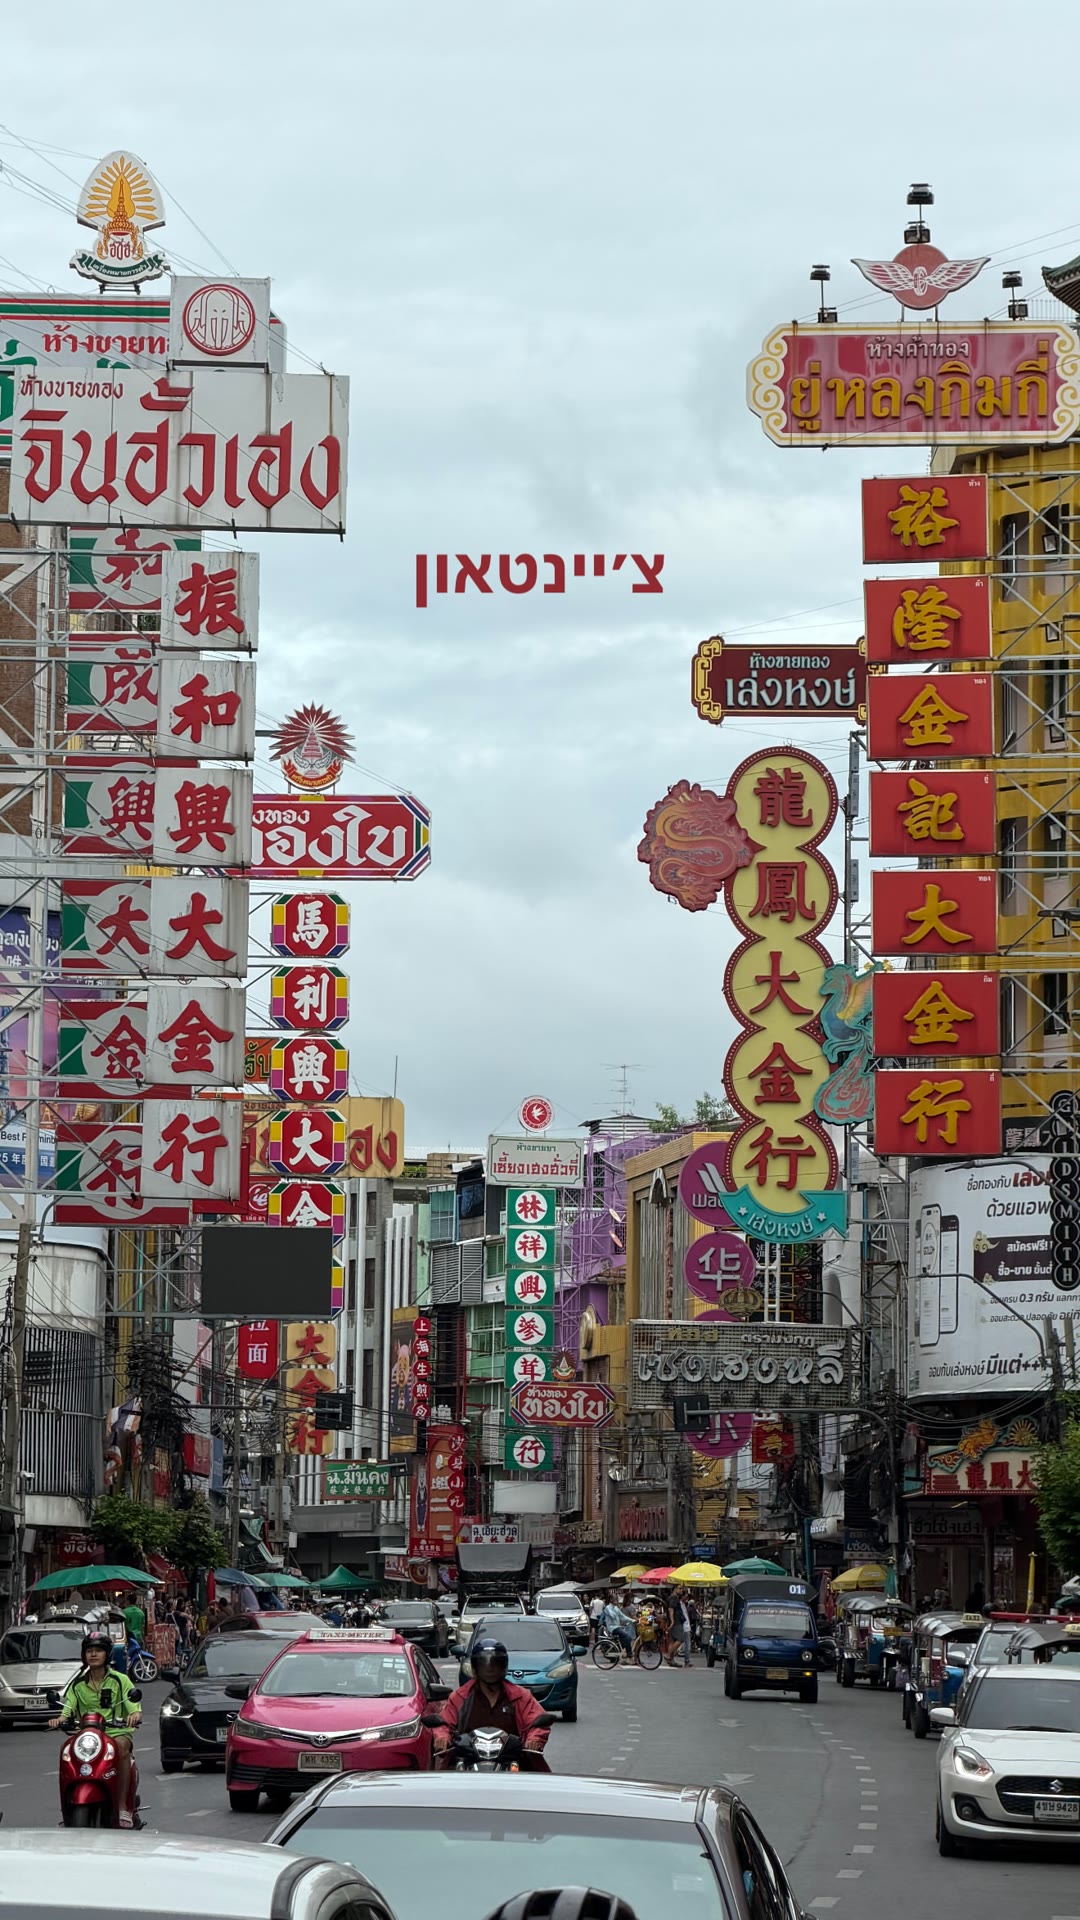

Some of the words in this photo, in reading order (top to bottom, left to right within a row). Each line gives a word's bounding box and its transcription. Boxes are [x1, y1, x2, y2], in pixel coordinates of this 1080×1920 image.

[42, 325, 169, 354] ห้างขายท
[866, 336, 970, 359] ห้างค้าทอง
[20, 374, 124, 399] ห้างขายทอง
[791, 340, 1049, 432] ยู่หลงกิมกี่
[749, 653, 831, 670] ห้างขายทอง
[725, 667, 856, 708] เล่งหงษ์
[888, 485, 974, 1145] 裕隆金記大金行
[153, 562, 245, 1187] 振和興大金行
[745, 767, 817, 1191] 龍鳳大金行
[1, 1131, 20, 1141] Best
[747, 1213, 814, 1238] เล่งหงษ์
[1034, 1261, 1053, 1275] ขั้นต่
[1019, 1293, 1033, 1303] 0.3
[527, 1386, 567, 1398] ห้างทอง
[1056, 1802, 1078, 1813] 9428
